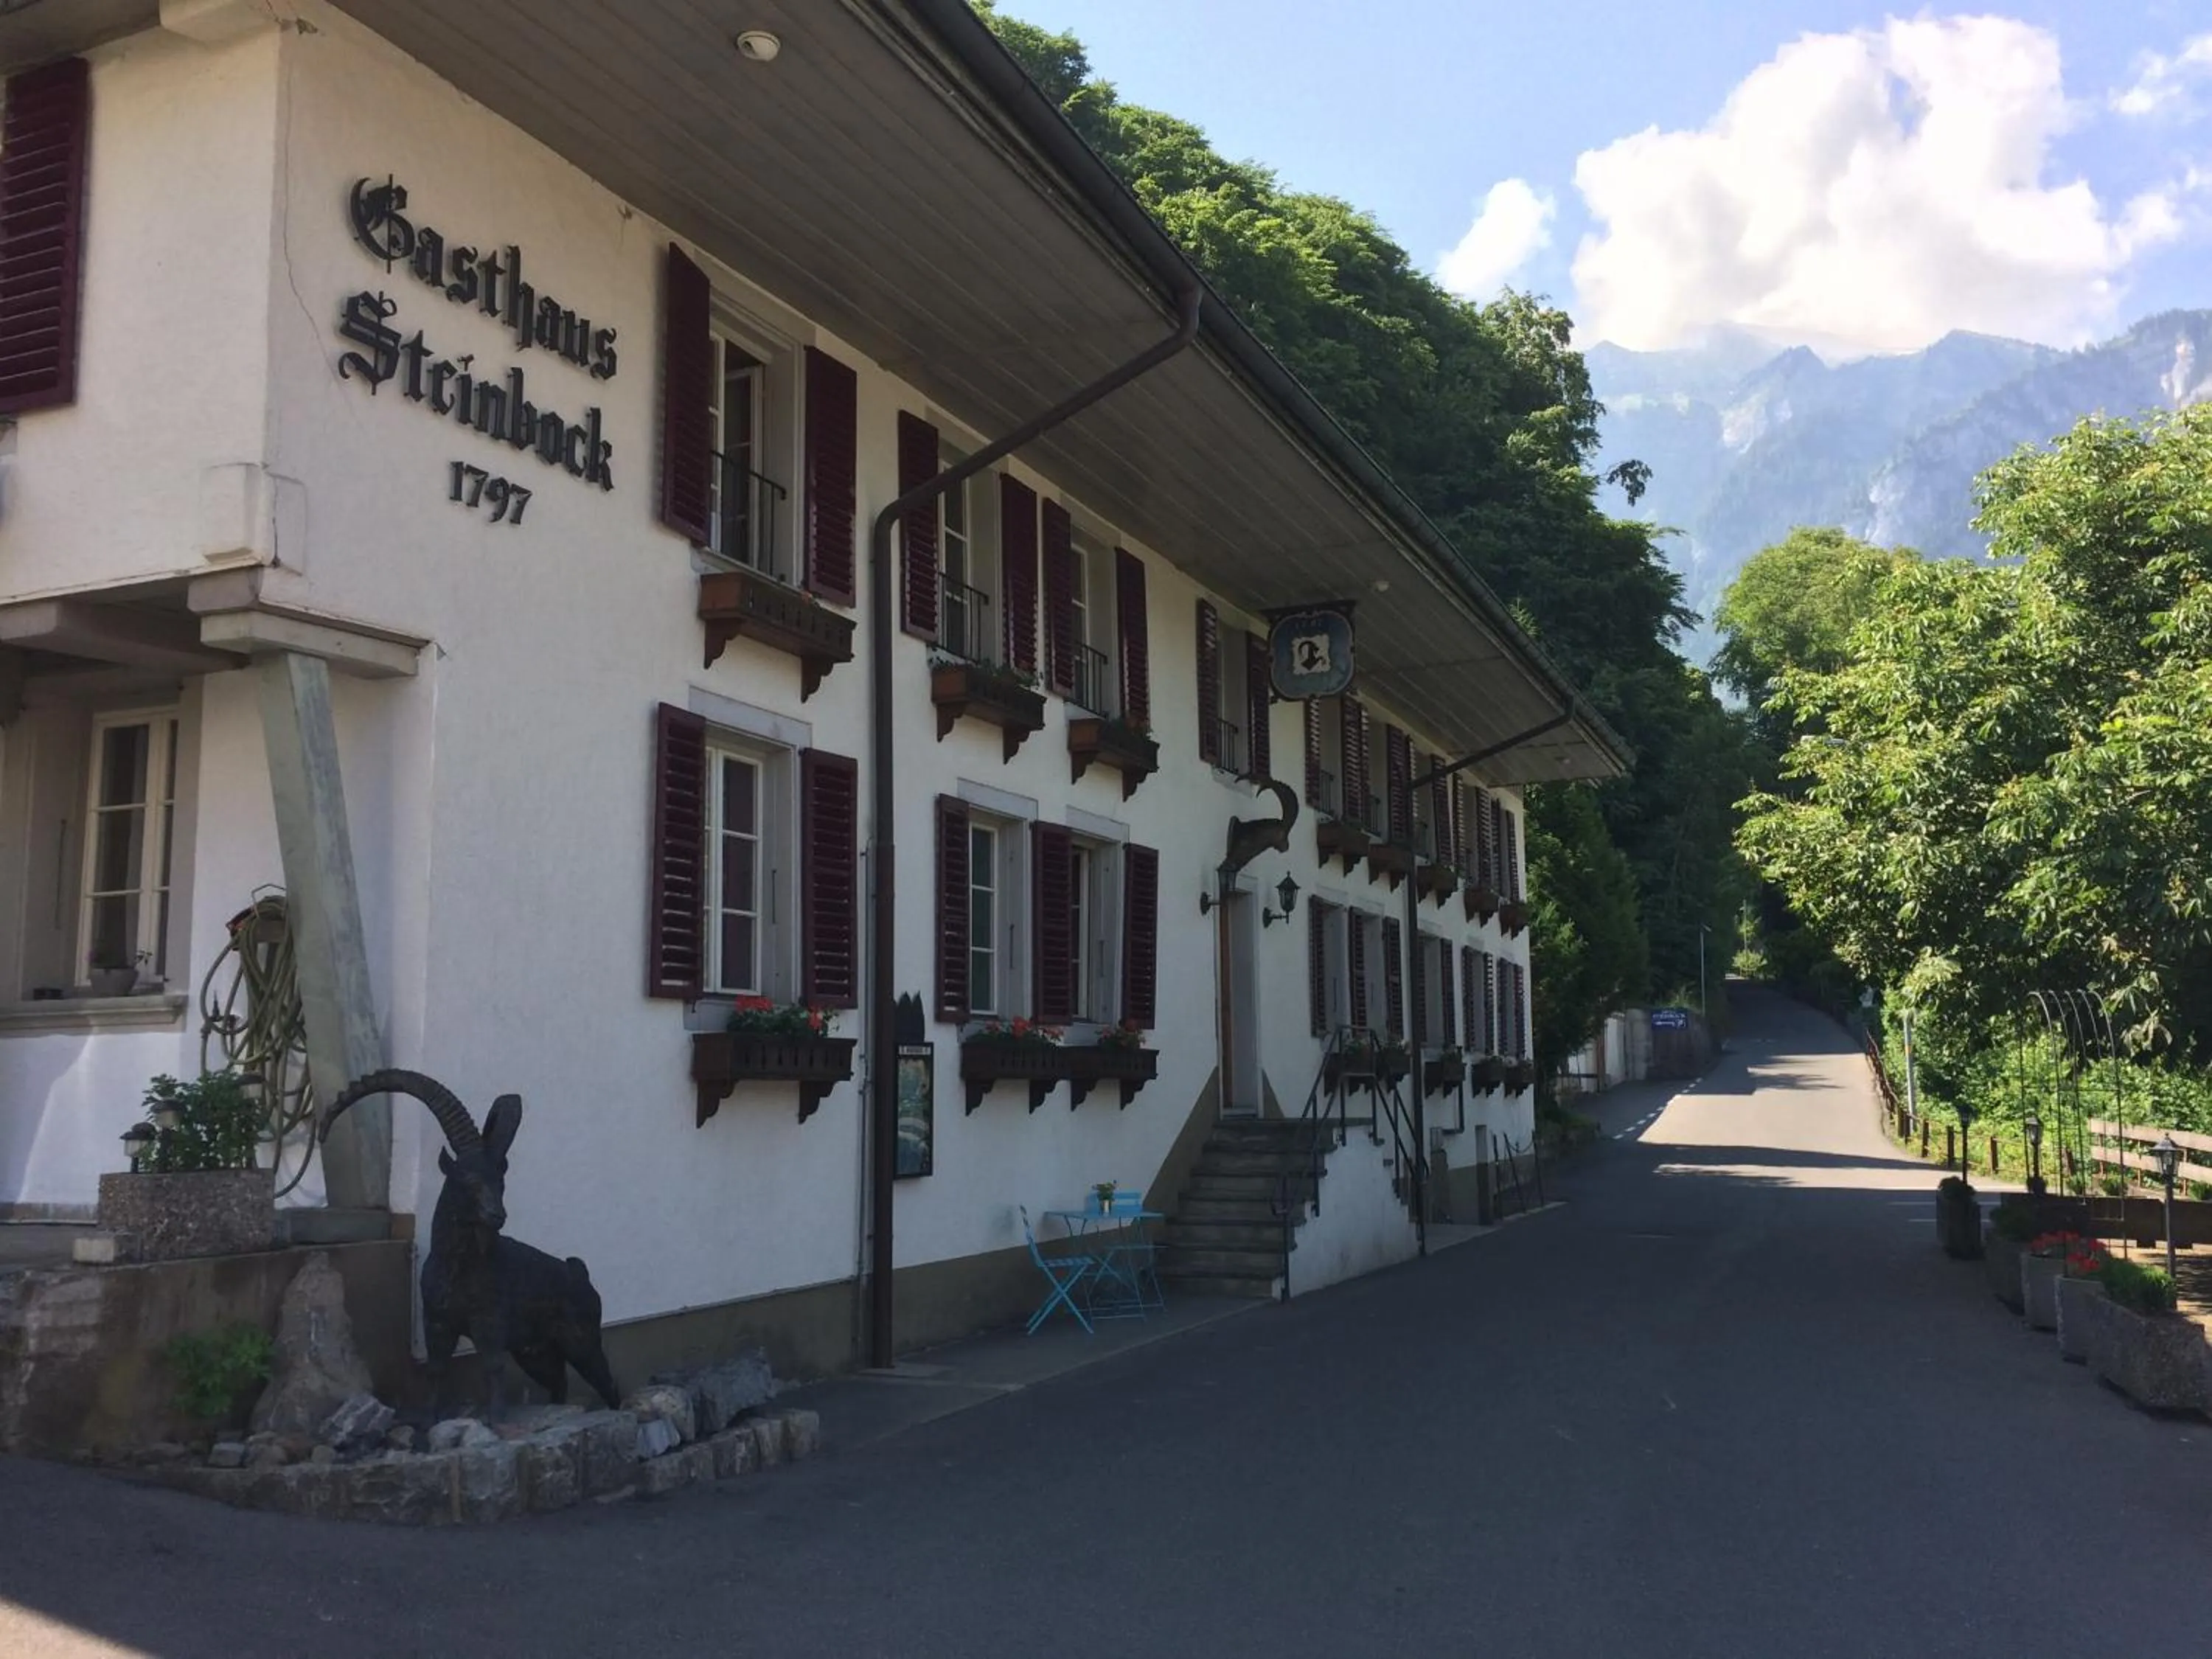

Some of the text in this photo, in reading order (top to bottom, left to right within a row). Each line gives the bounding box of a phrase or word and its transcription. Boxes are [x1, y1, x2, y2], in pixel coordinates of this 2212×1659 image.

[349, 174, 617, 380] Gasthaus
[338, 291, 613, 492] Steinbock
[449, 461, 532, 525] 1797
